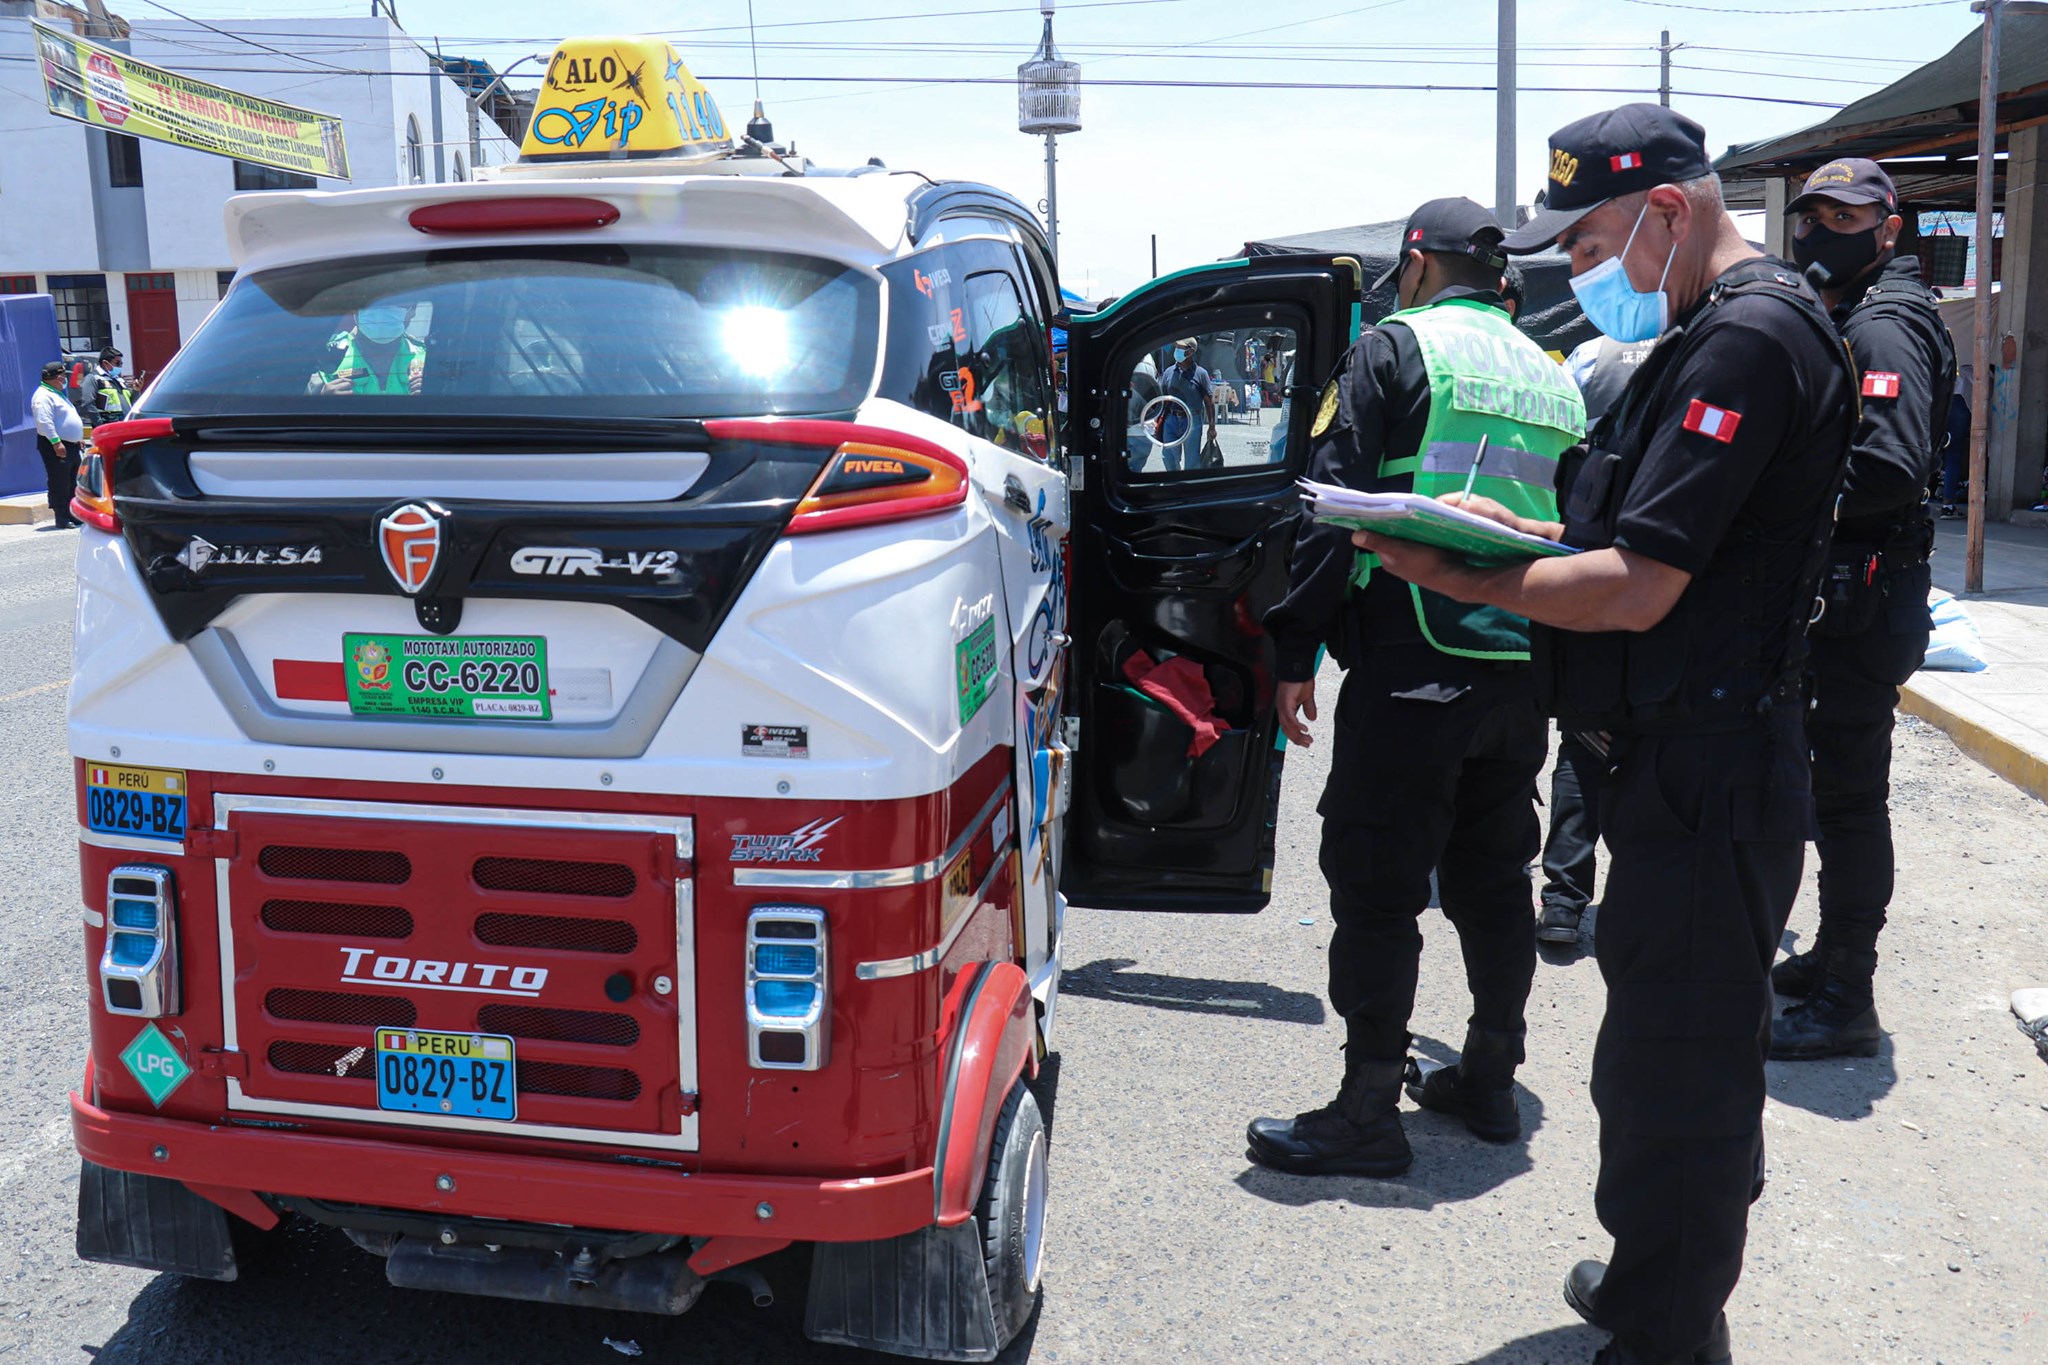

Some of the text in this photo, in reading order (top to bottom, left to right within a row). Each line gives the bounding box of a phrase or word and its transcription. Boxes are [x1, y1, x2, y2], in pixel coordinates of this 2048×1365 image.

[565, 56, 617, 85] ALO
[124, 61, 158, 81] RATERO
[161, 74, 169, 85] SI
[172, 77, 180, 89] TE
[182, 79, 232, 105] AGARRAMOS
[232, 94, 244, 108] NO
[245, 98, 260, 112] VAS
[267, 105, 276, 116] LA
[277, 107, 315, 124] COMISARIA
[176, 89, 229, 122] VAMOS
[231, 105, 242, 126] A
[667, 91, 724, 141] 1140
[133, 101, 143, 113] SI
[266, 135, 290, 152] SERAS
[290, 139, 326, 159] LINCHADO
[533, 97, 643, 148] Vip
[228, 140, 265, 158] ESTAMOS
[1440, 329, 1574, 391] POLICIA
[1622, 351, 1633, 363] DE
[1456, 378, 1582, 434] NACIONAL
[844, 460, 905, 474] FIVESA
[510, 547, 679, 576] GTR-V2
[404, 641, 536, 657] MOTOTAXI AUTORIZADO
[403, 660, 541, 694] CC-6220
[408, 697, 465, 706] EMPRESA VIP
[411, 706, 431, 714] 1140
[475, 702, 541, 713] PLACA: 0829-BZ
[118, 771, 149, 789] PERÚ
[91, 788, 183, 835] 0829-BZ
[729, 847, 824, 862] SPARK
[731, 834, 796, 848] TWIN
[340, 947, 549, 991] TORITO
[417, 1036, 471, 1056] PERU
[137, 1051, 174, 1078] LPG
[384, 1054, 507, 1104] 0829-BZ
